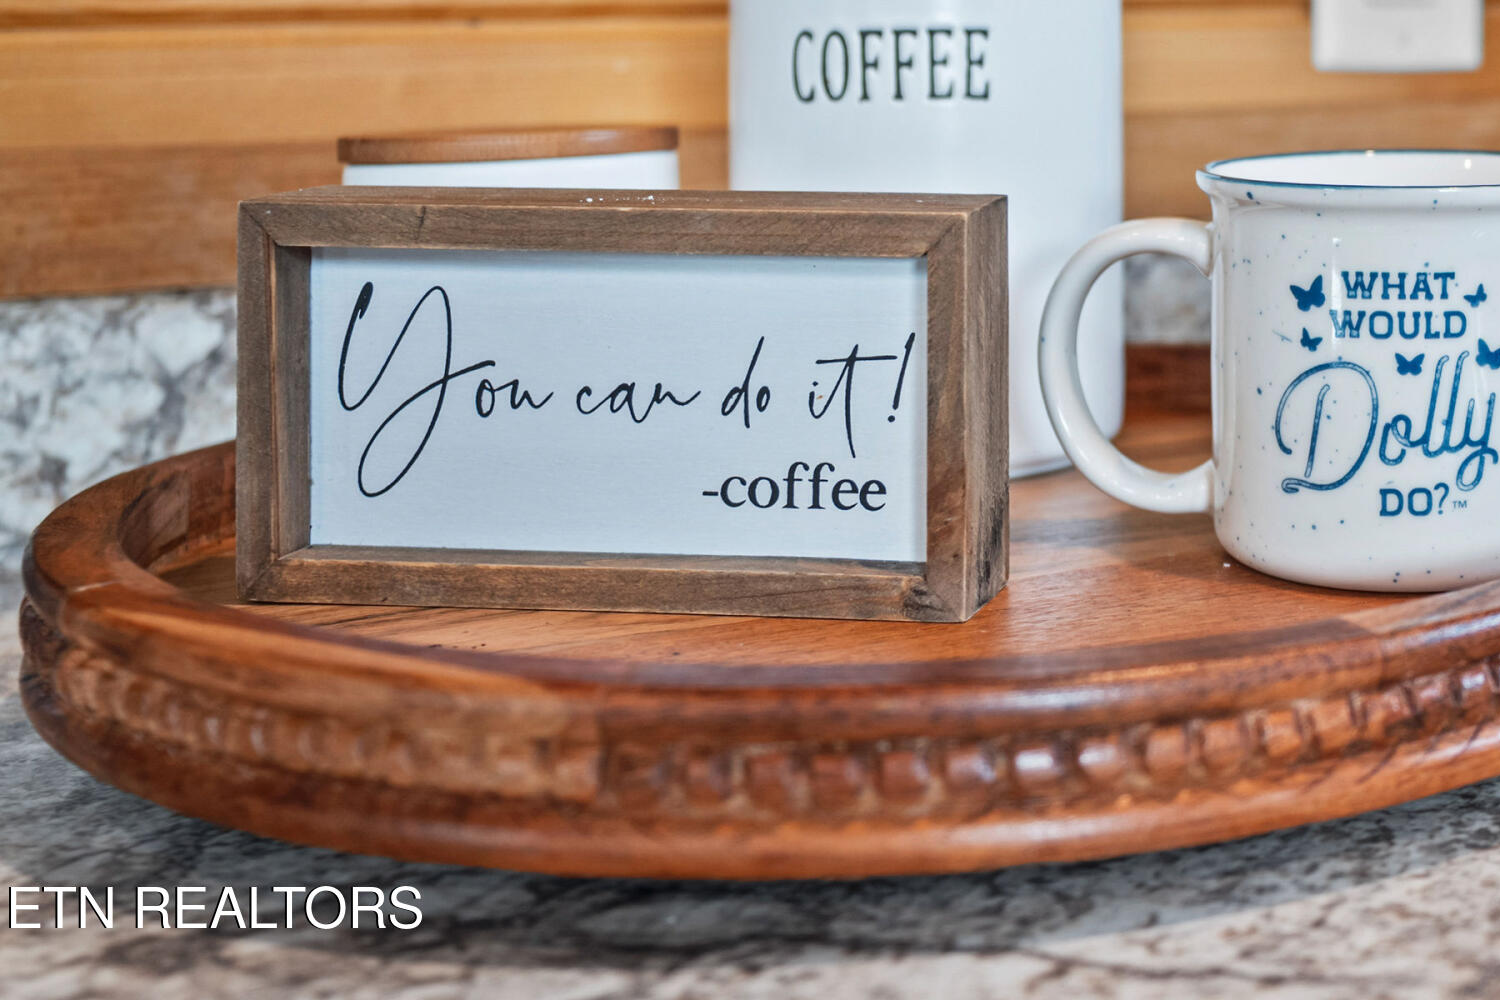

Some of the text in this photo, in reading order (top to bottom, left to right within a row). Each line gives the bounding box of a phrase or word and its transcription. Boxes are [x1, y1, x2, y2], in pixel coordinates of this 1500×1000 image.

[791, 27, 991, 104] COFFEE
[1341, 271, 1456, 300] WHAT
[1329, 309, 1467, 339] WOULD
[338, 281, 917, 498] You can do it!
[1274, 350, 1499, 493] Dolly
[702, 461, 888, 512] -coffee
[1379, 482, 1450, 517] DO?
